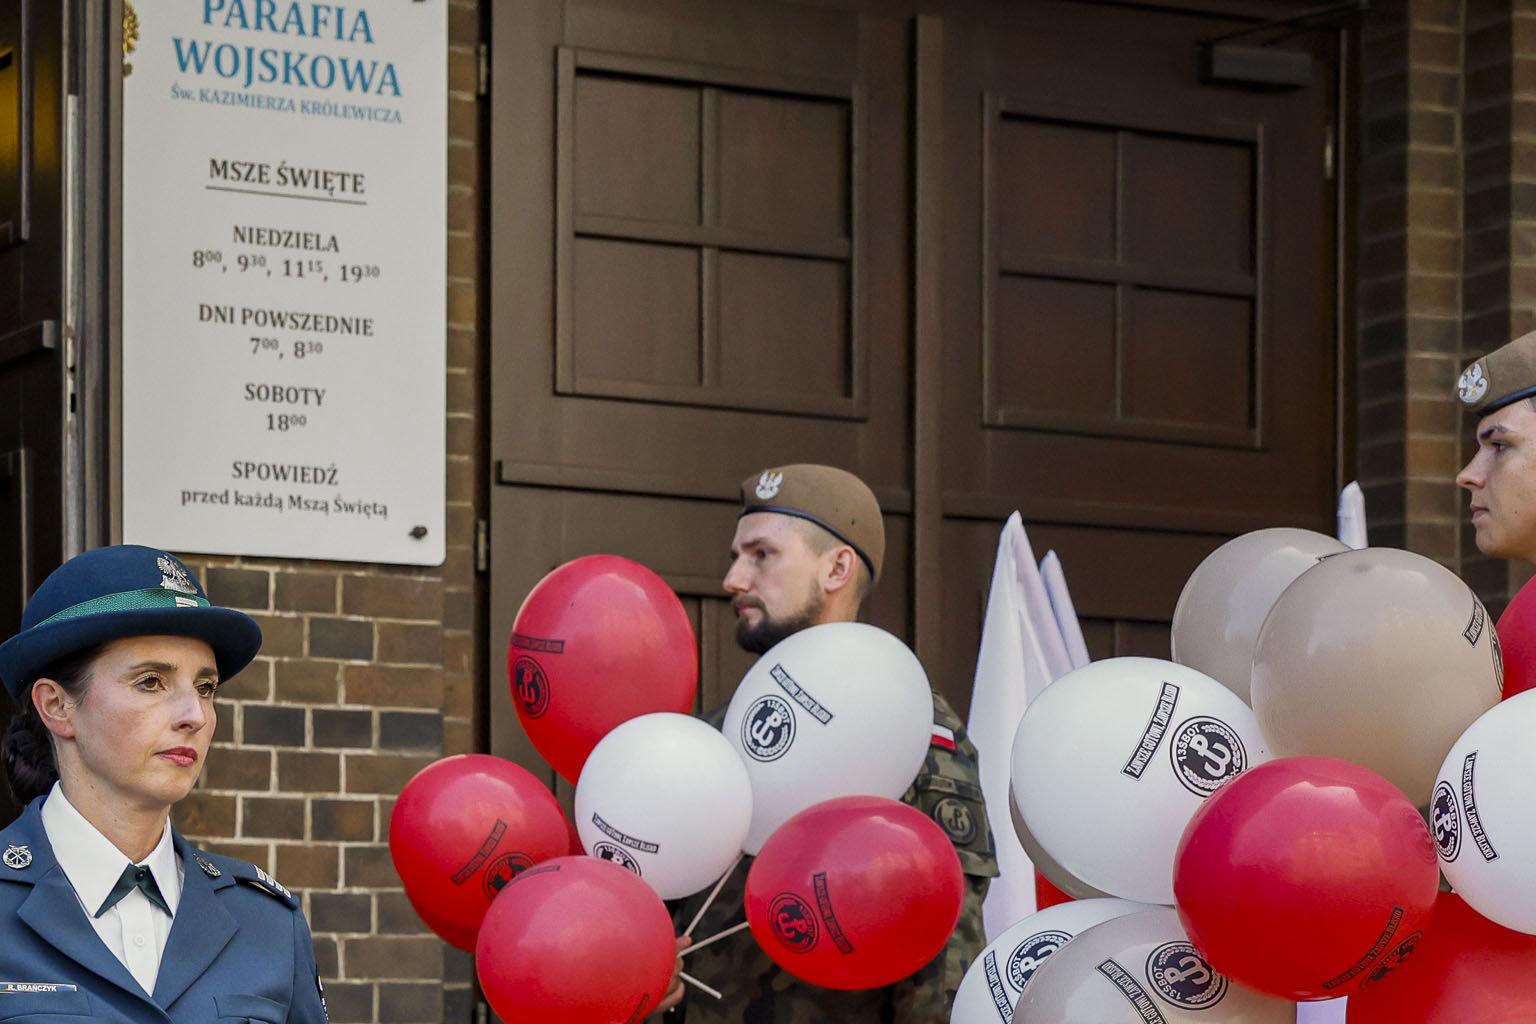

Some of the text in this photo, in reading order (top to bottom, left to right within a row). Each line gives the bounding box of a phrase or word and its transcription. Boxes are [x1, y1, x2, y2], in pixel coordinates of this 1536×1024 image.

[203, 0, 375, 44] PARAFIA
[171, 37, 403, 97] WOJSKOWA
[199, 88, 296, 113] KAZIMIERZA
[300, 98, 403, 124] KRÓLEWICZA
[209, 158, 366, 197] MSZE ŚWIĘTE
[233, 225, 340, 253] NIEDZIELA
[198, 303, 375, 337] DNI POWSZEDNIE
[244, 383, 326, 407] SOBOTY
[181, 490, 389, 519] przed każdą Mszą Świętą
